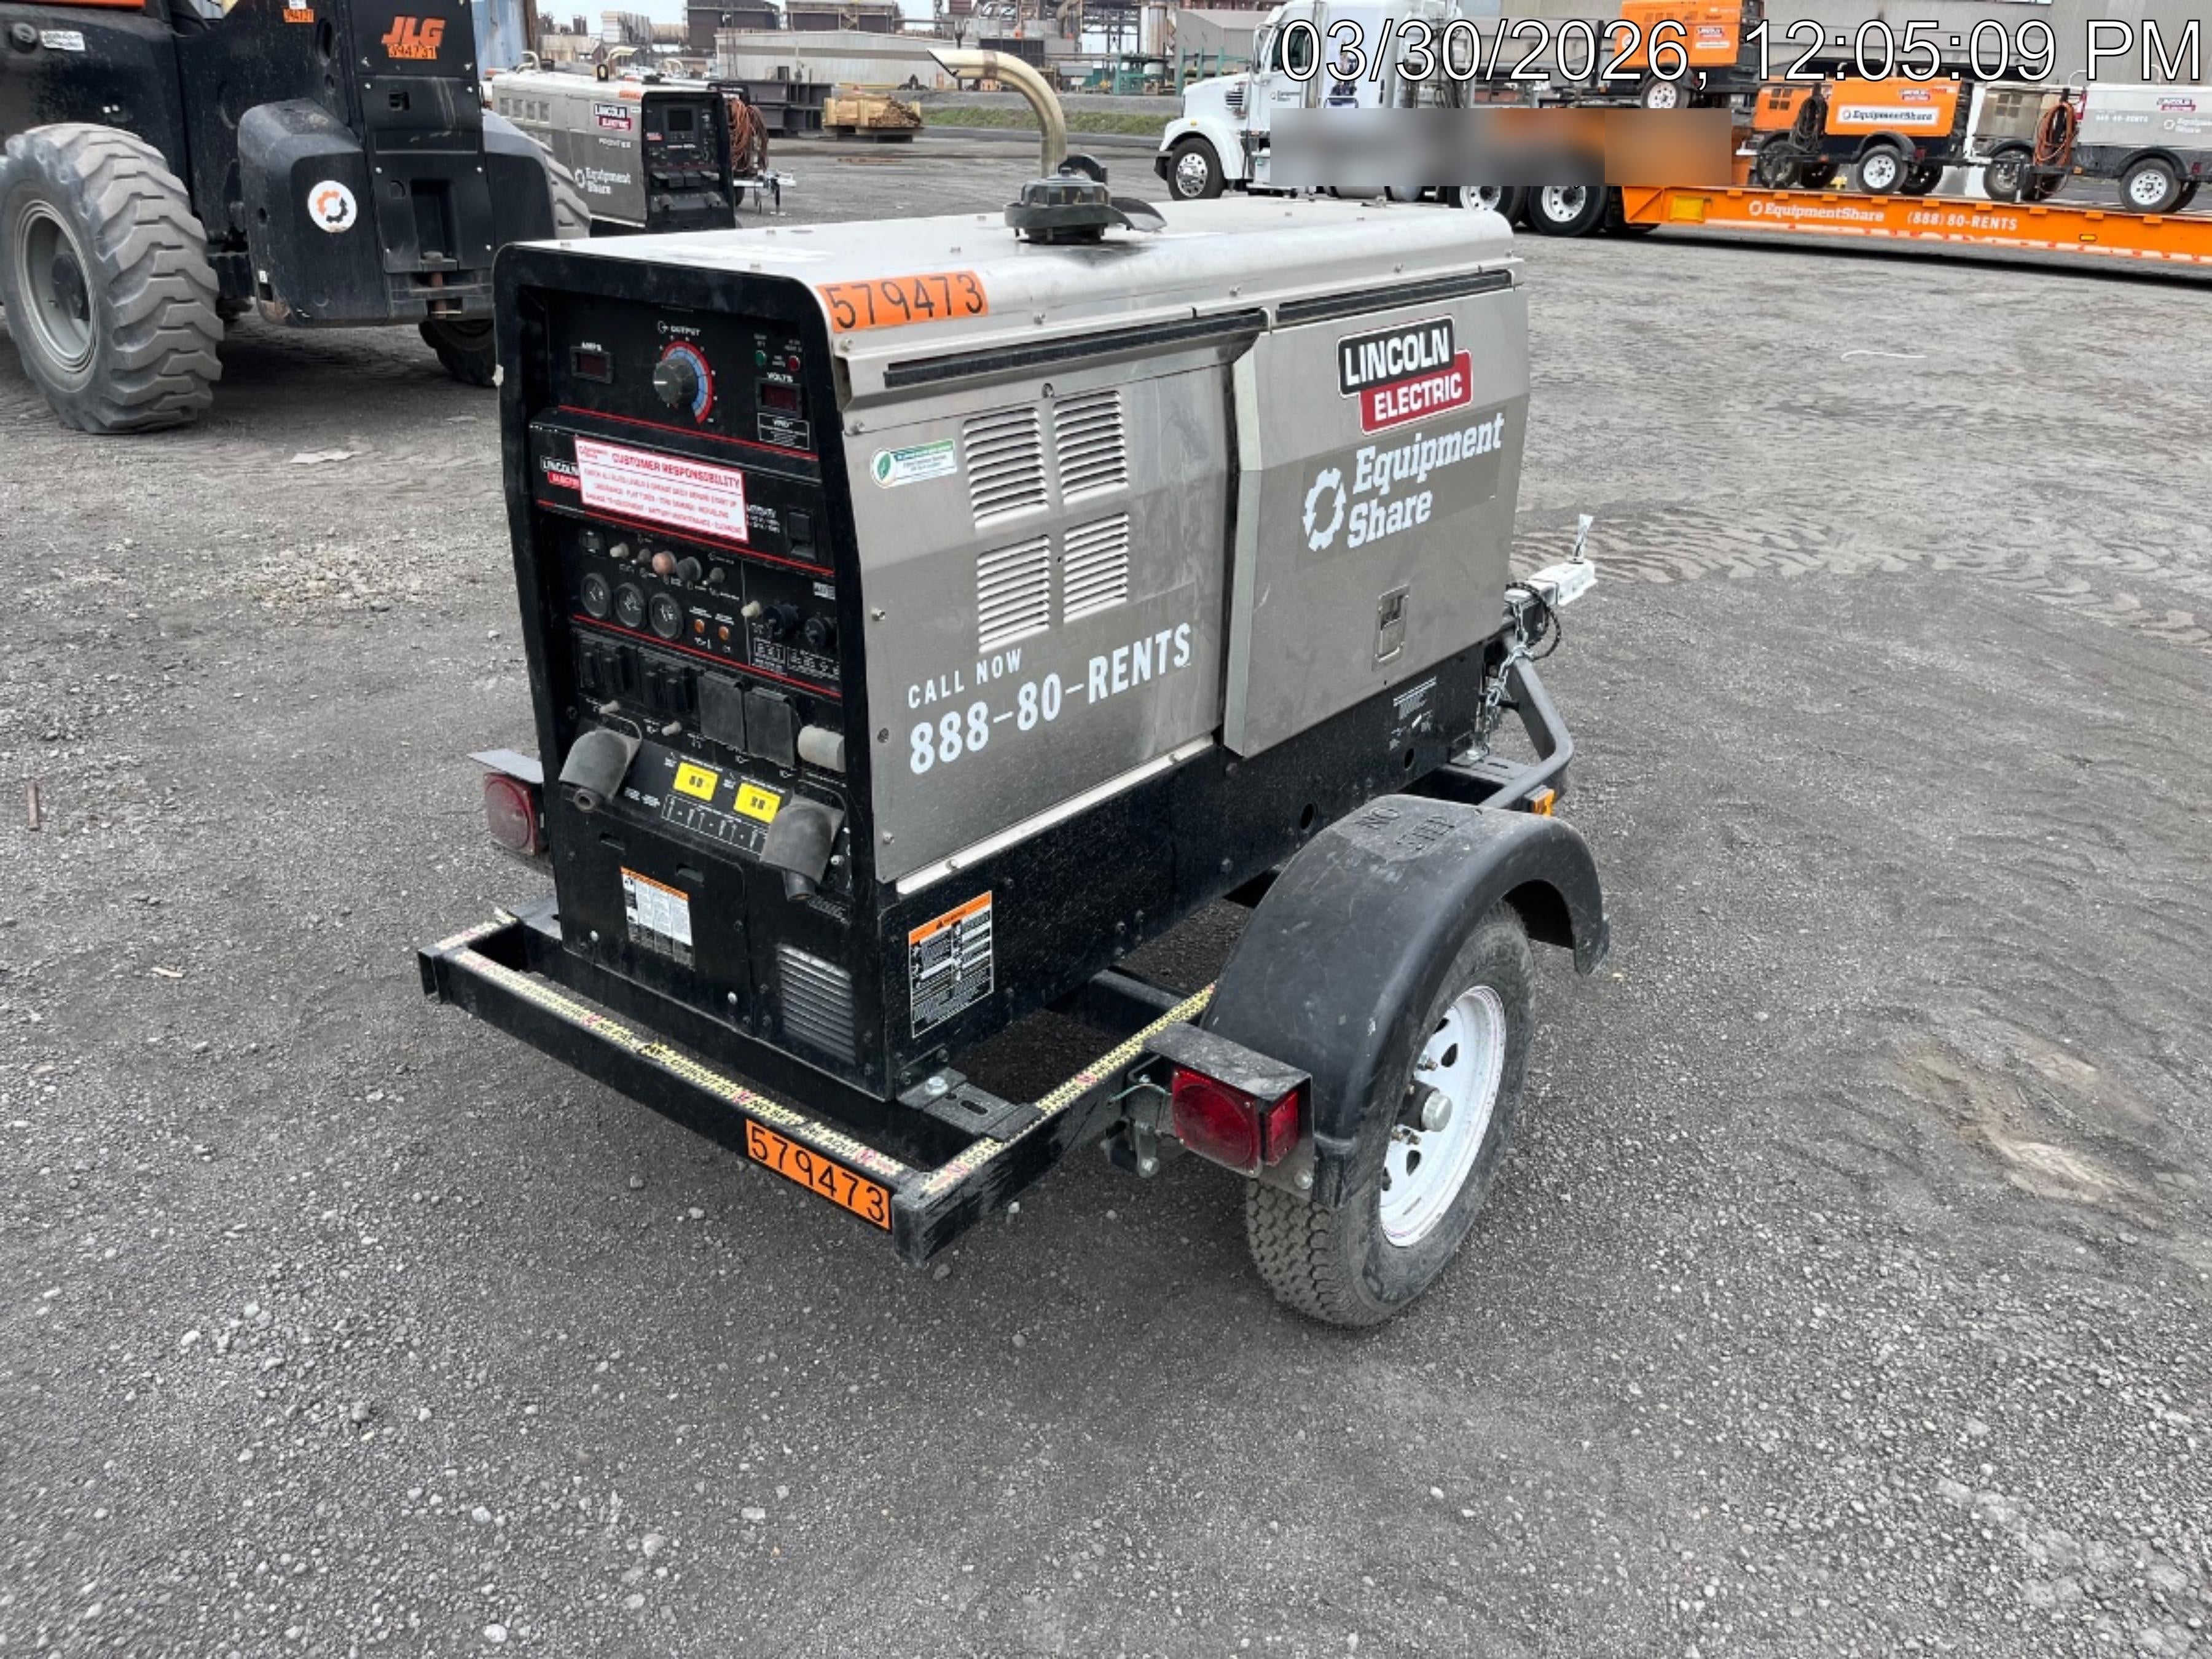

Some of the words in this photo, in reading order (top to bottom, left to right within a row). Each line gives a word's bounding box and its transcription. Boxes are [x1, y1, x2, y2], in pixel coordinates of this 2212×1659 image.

[382, 16, 446, 46] JLG
[1764, 202, 1885, 221] EquipmentShare
[1907, 211, 1944, 226] (888)
[1947, 213, 2018, 231] 80-RENTS
[825, 274, 983, 329] 579473
[1344, 326, 1450, 386] LINCOLN
[1374, 372, 1462, 422] ELECTRIC
[611, 453, 660, 472] CUSTOMER
[662, 462, 740, 489] RESPONSIBILITY
[1352, 412, 1505, 495] Equipment
[1347, 490, 1433, 549] Share
[908, 670, 965, 709] CALL
[976, 648, 1022, 685] NOW
[909, 622, 1191, 774] 888-80-RENTS
[751, 1126, 885, 1223] 579473
